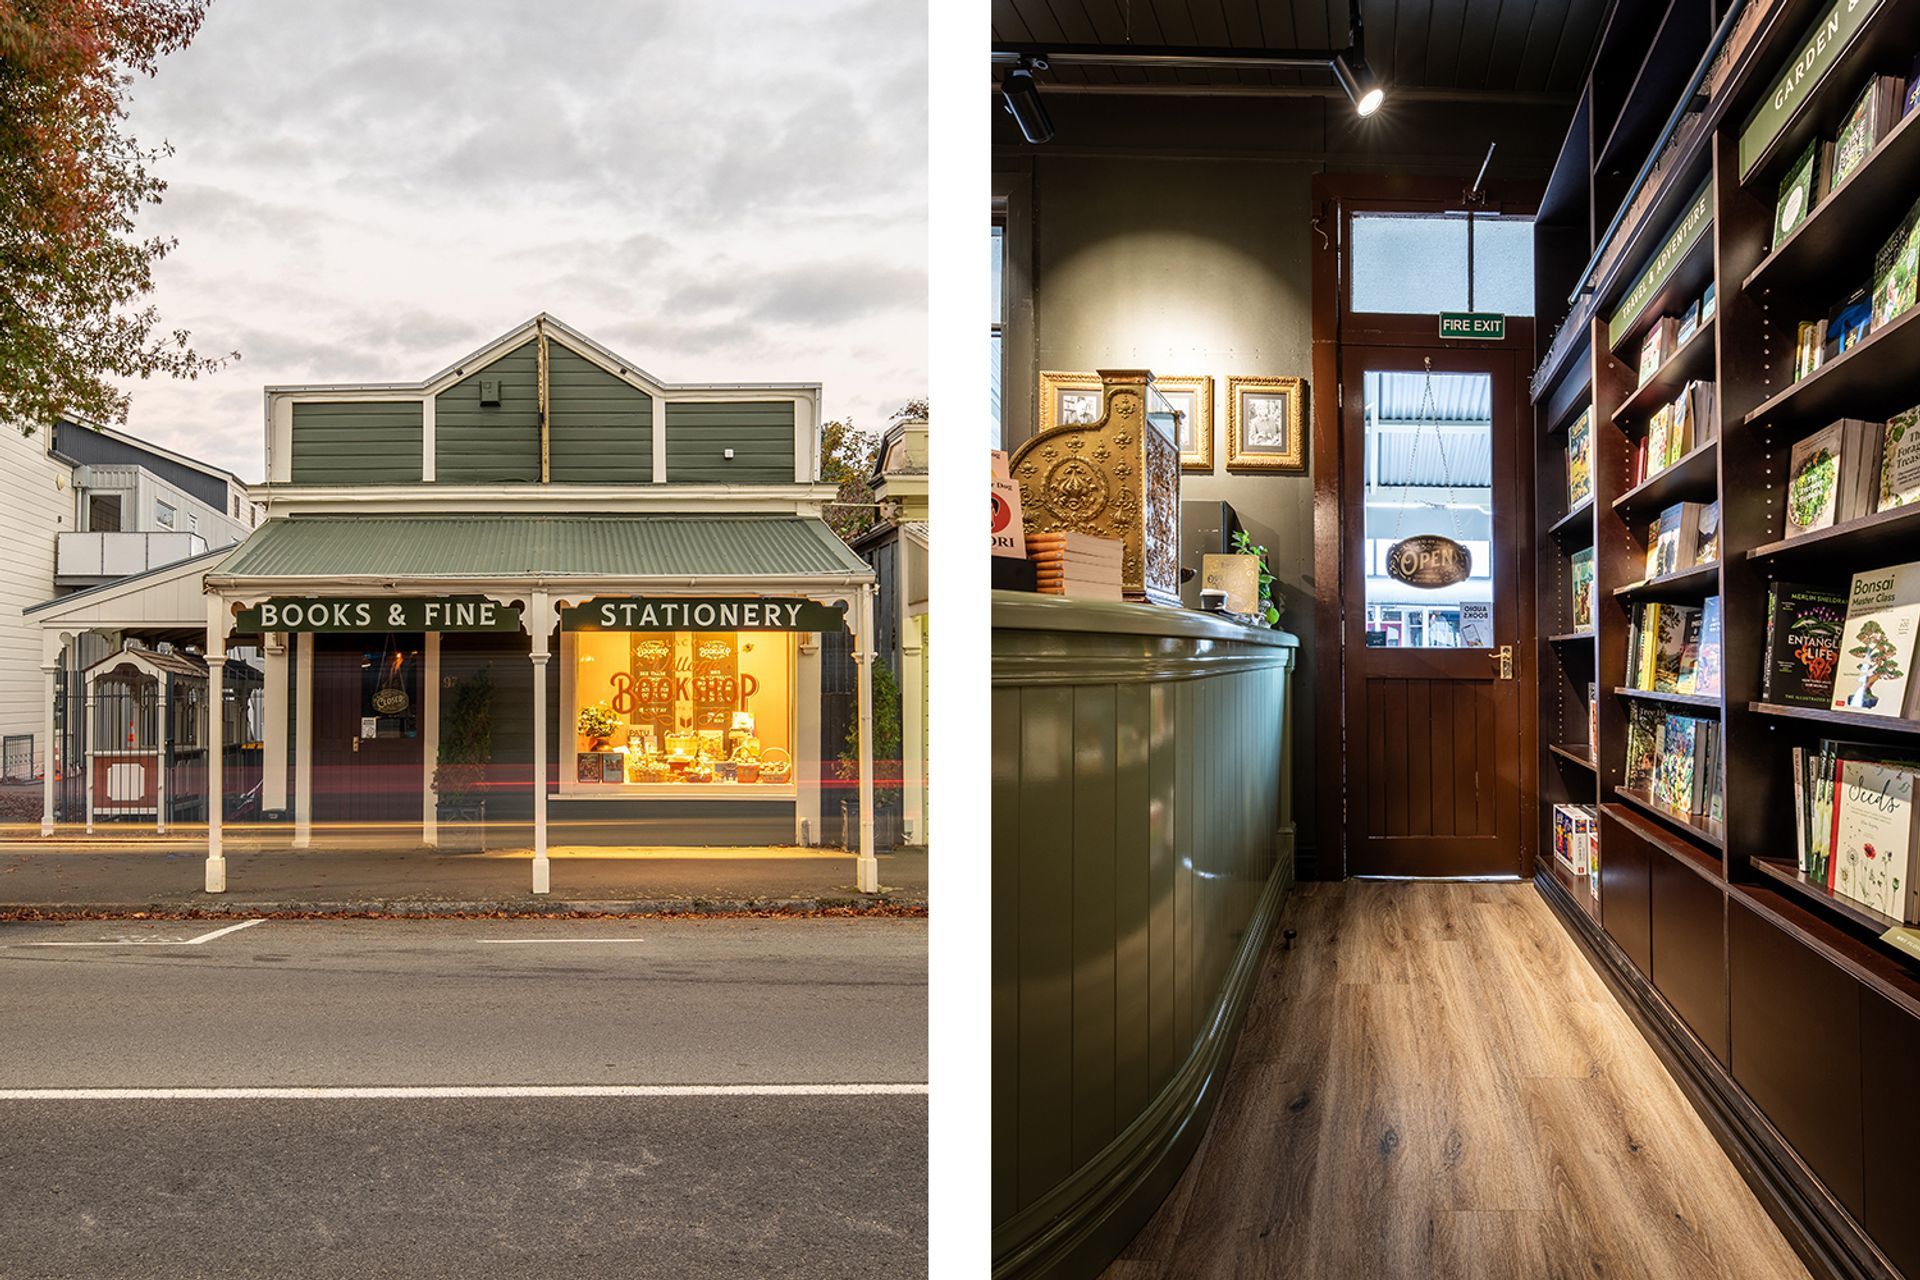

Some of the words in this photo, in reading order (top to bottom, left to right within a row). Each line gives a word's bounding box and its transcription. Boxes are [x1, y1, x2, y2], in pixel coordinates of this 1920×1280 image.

[1774, 11, 1839, 110] GARDEN
[1622, 282, 1648, 319] TRAVEL
[1656, 198, 1707, 275] ADVENTURE
[1443, 319, 1471, 331] FIRE
[1474, 319, 1502, 332] EXIT
[1400, 548, 1454, 576] OPEN
[1853, 574, 1896, 596] Bonsai
[1791, 593, 1817, 602] MERLIN
[1851, 596, 1875, 607] Master
[1875, 592, 1896, 603] Class
[261, 603, 372, 627] BOOKS
[387, 603, 407, 626] &
[424, 603, 497, 626] FINE
[600, 603, 803, 627] STATIONERY
[1807, 648, 1834, 661] LIFE
[1848, 775, 1901, 814] Seeds
